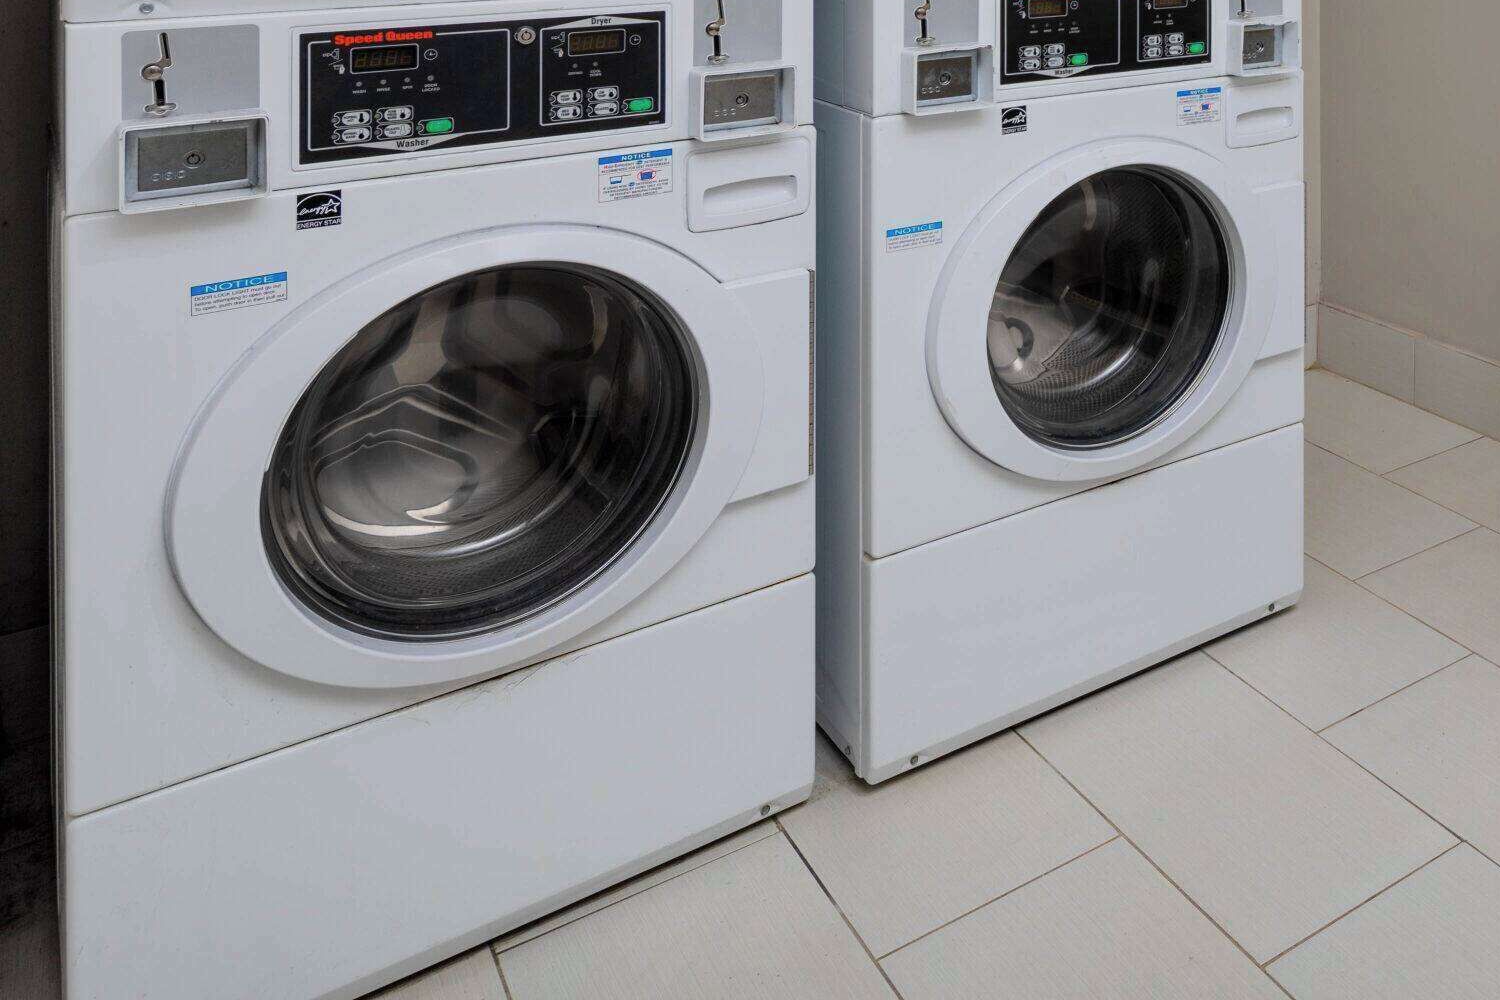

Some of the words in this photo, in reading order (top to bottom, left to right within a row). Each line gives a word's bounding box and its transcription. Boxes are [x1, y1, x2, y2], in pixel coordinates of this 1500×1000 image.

[591, 18, 611, 26] Dryer
[335, 33, 383, 46] Speed
[386, 31, 433, 41] Queen
[397, 139, 429, 148] Washer
[297, 221, 323, 229] ENERGY
[895, 224, 933, 235] NOTICE
[205, 276, 273, 292] NOTICE
